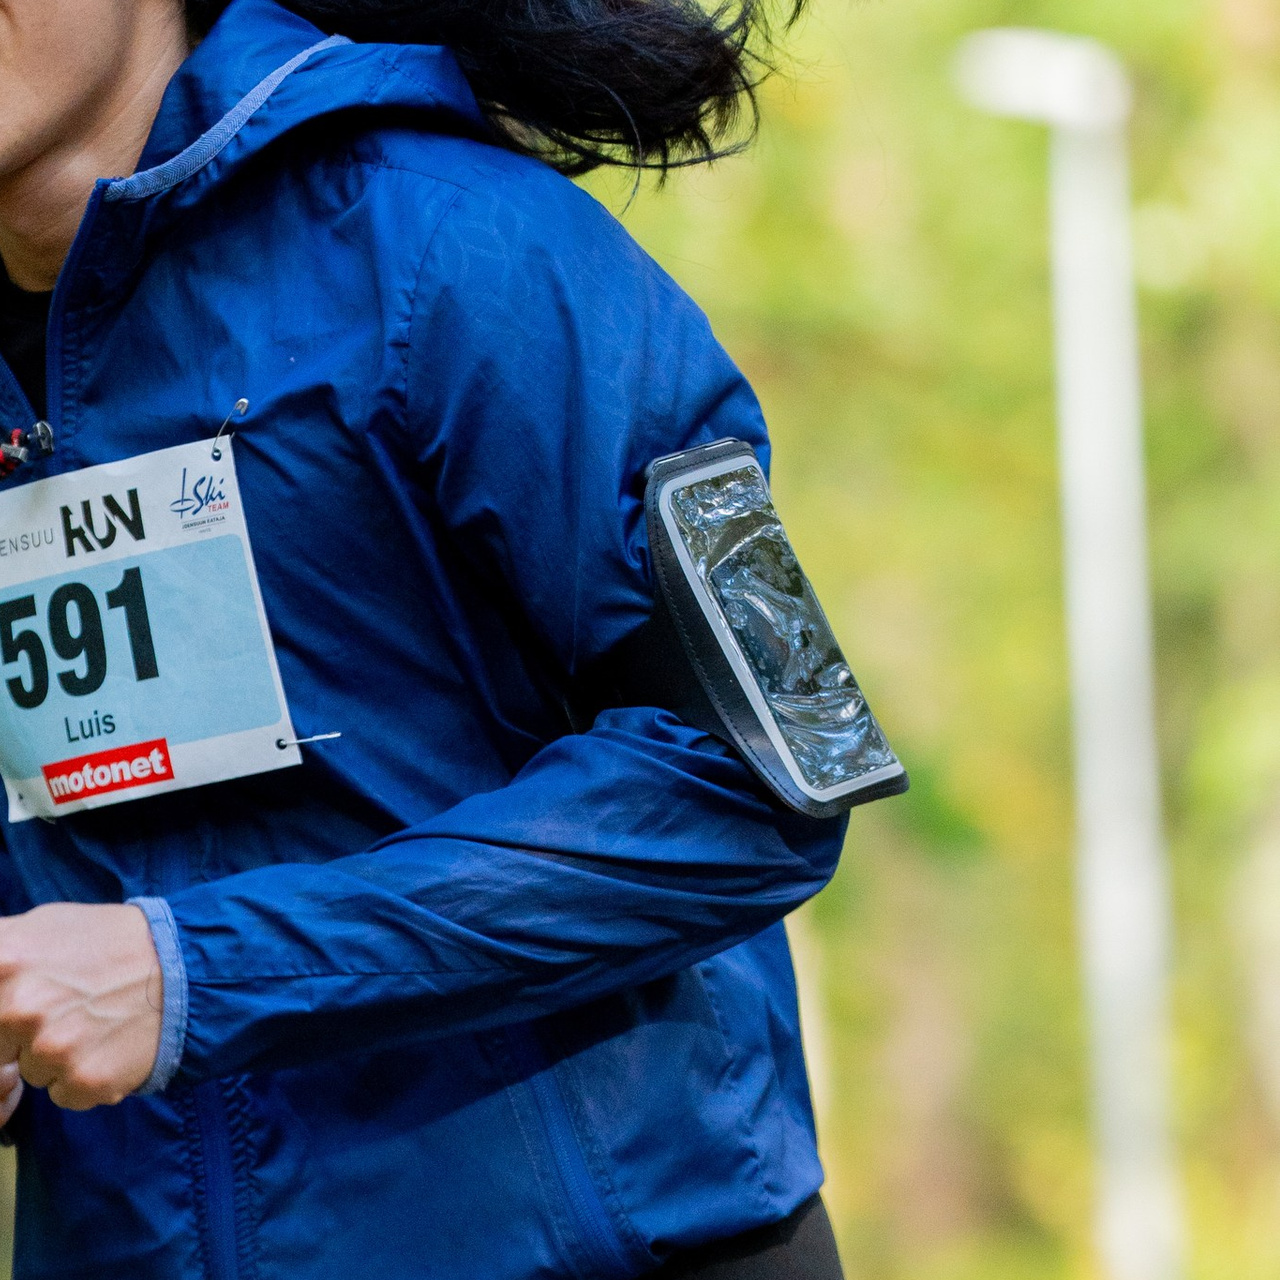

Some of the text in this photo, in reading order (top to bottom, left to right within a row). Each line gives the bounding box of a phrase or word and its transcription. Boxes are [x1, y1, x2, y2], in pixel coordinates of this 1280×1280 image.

[192, 475, 226, 516] Ski
[207, 501, 230, 513] TEAM
[59, 487, 146, 559] RUN
[64, 710, 116, 743] Luis
[48, 747, 168, 798] motonet
